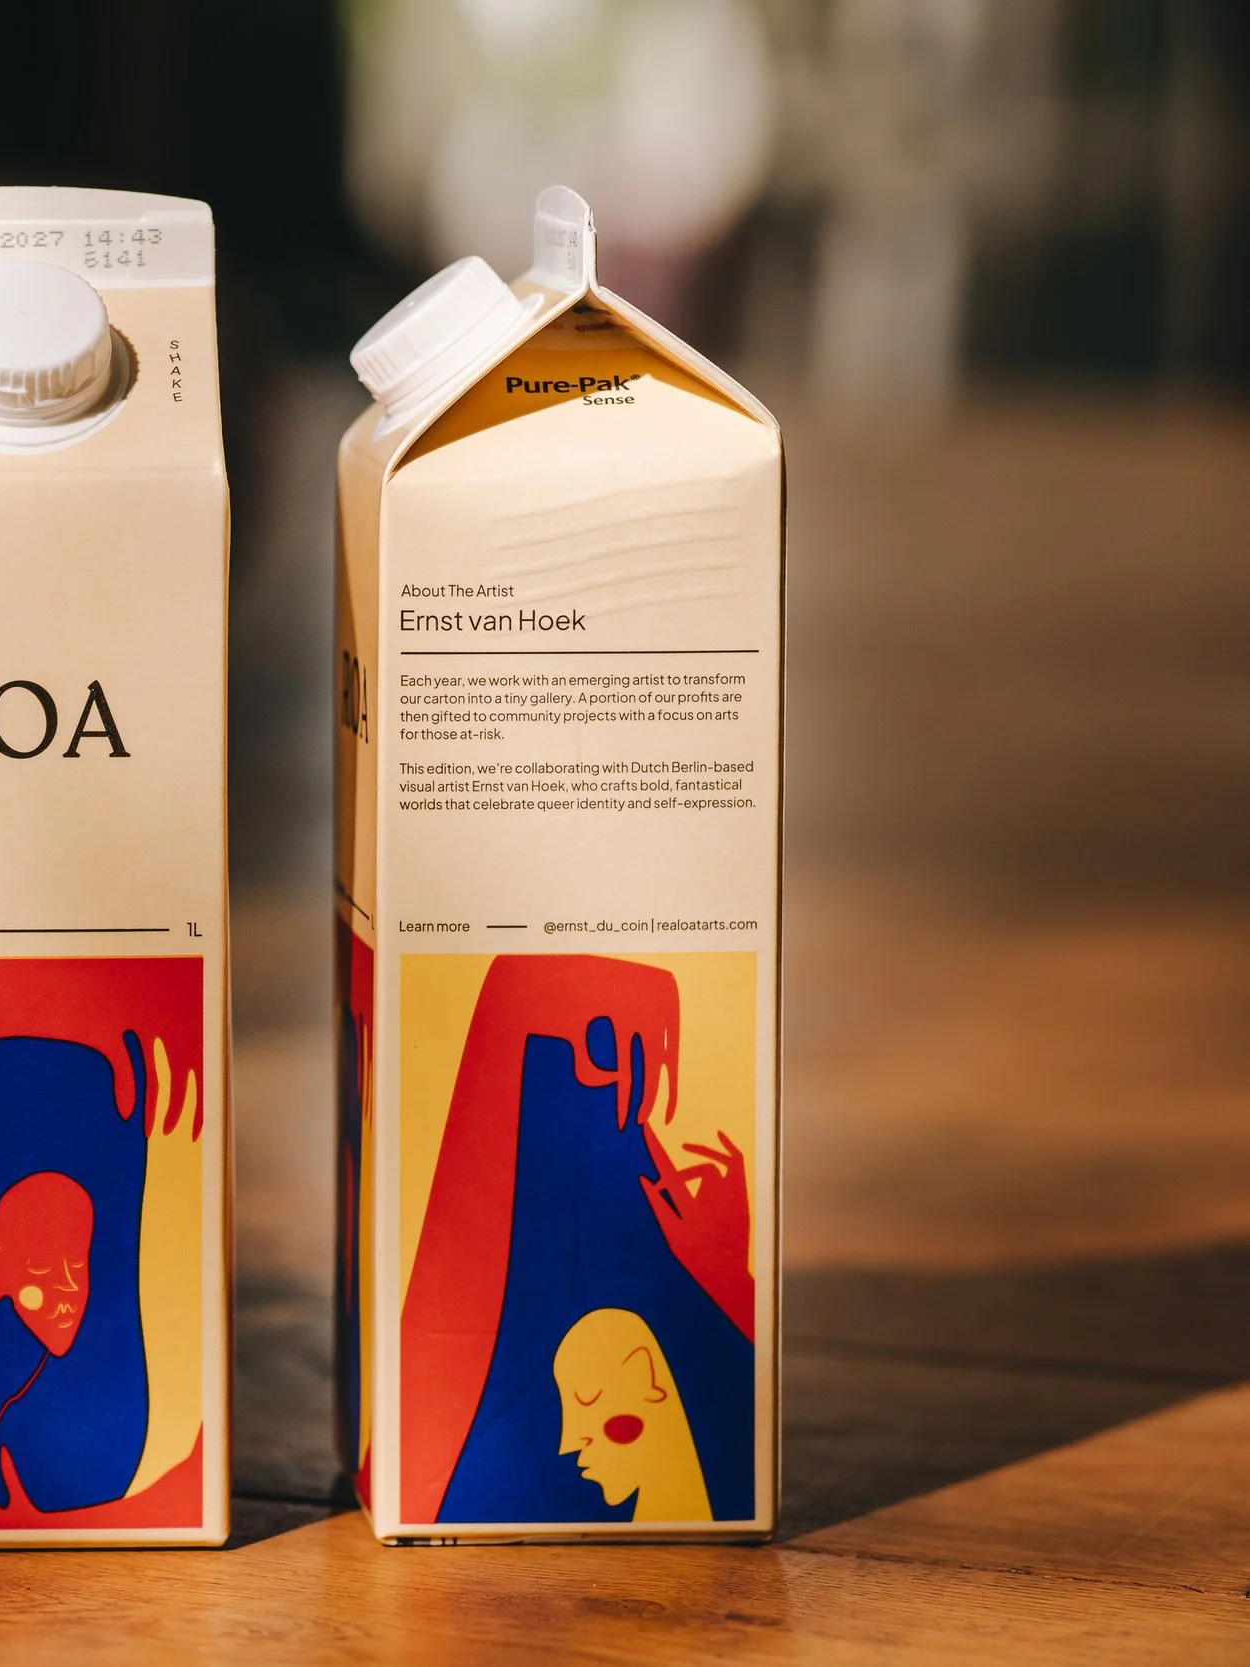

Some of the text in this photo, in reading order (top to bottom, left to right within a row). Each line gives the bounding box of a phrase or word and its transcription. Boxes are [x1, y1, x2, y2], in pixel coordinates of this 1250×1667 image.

[84, 228, 163, 247] 14:43
[169, 340, 183, 402] SHAKE
[583, 395, 635, 406] Sense
[401, 584, 514, 597] About The Artist
[400, 609, 586, 631] Ernst van Hoek
[400, 673, 745, 689] Each year, we work with an emerging artist to transform
[400, 691, 742, 707] our carton into a tiny gallery. A portion of our profits are
[400, 709, 739, 725] then gifted to community projects with a focus on arts
[400, 728, 504, 740] for those at-risk.
[399, 762, 424, 775] This
[427, 763, 475, 775] edition,
[515, 762, 600, 776] collaborating
[602, 762, 628, 773] with
[631, 761, 669, 773] Dutch
[672, 760, 754, 773] Berlin-based
[399, 778, 742, 793] visual artist Ernst van Hoek, who crafts bold, fantastical
[399, 797, 756, 812] worlds that celebrate queer identity and self-expression.
[187, 922, 203, 937] 1L
[399, 920, 470, 932] Learn more
[544, 920, 648, 935] @ernst_du_coin
[657, 919, 758, 931] realoatarts.com
